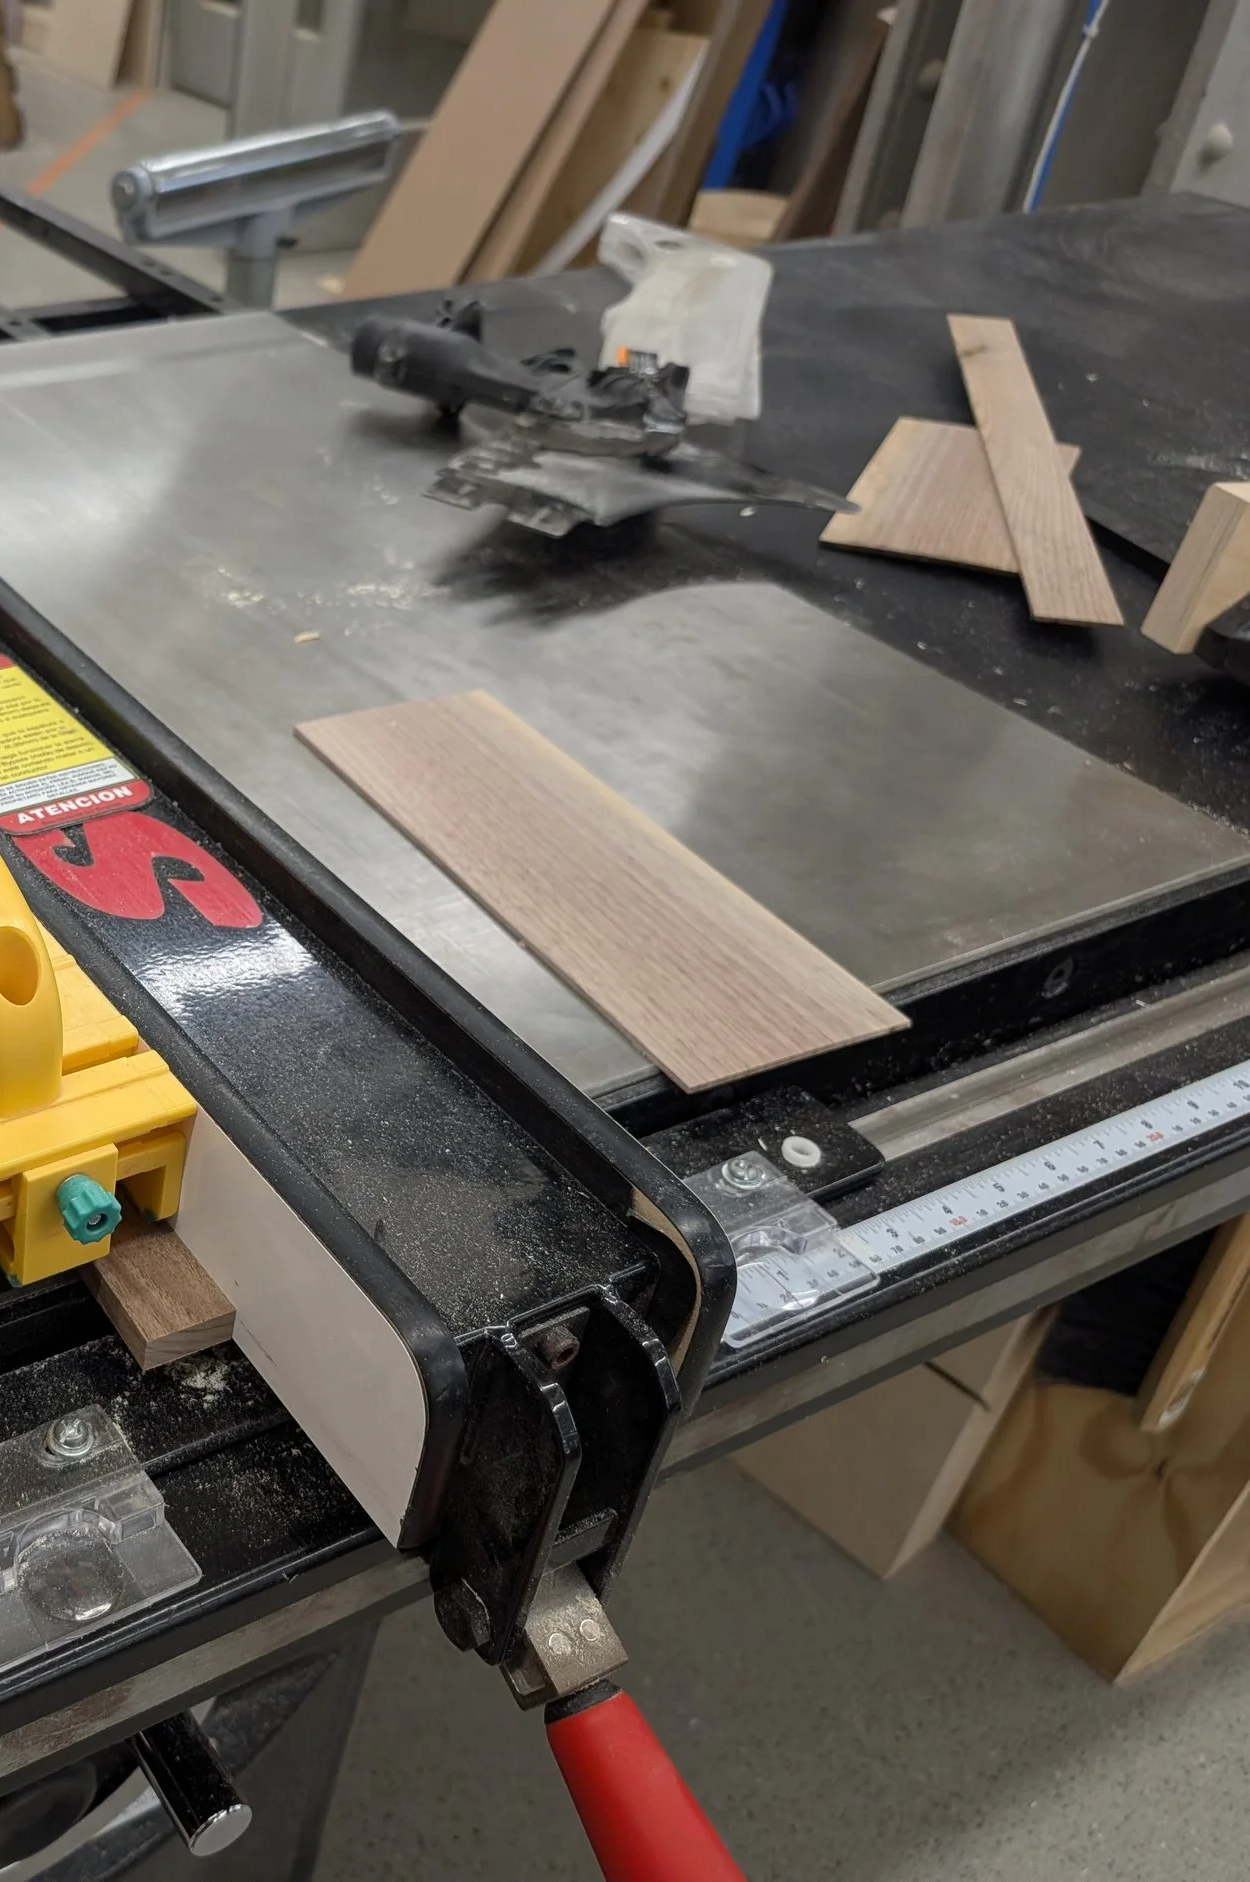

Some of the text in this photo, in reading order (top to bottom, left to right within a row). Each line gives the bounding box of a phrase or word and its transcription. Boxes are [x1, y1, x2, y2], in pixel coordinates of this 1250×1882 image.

[17, 785, 133, 824] ATENCION
[886, 1227, 899, 1239] 3
[941, 1204, 954, 1215] 4
[992, 1182, 1006, 1193] 5
[1043, 1160, 1057, 1171] 6
[1093, 1139, 1106, 1150] 7
